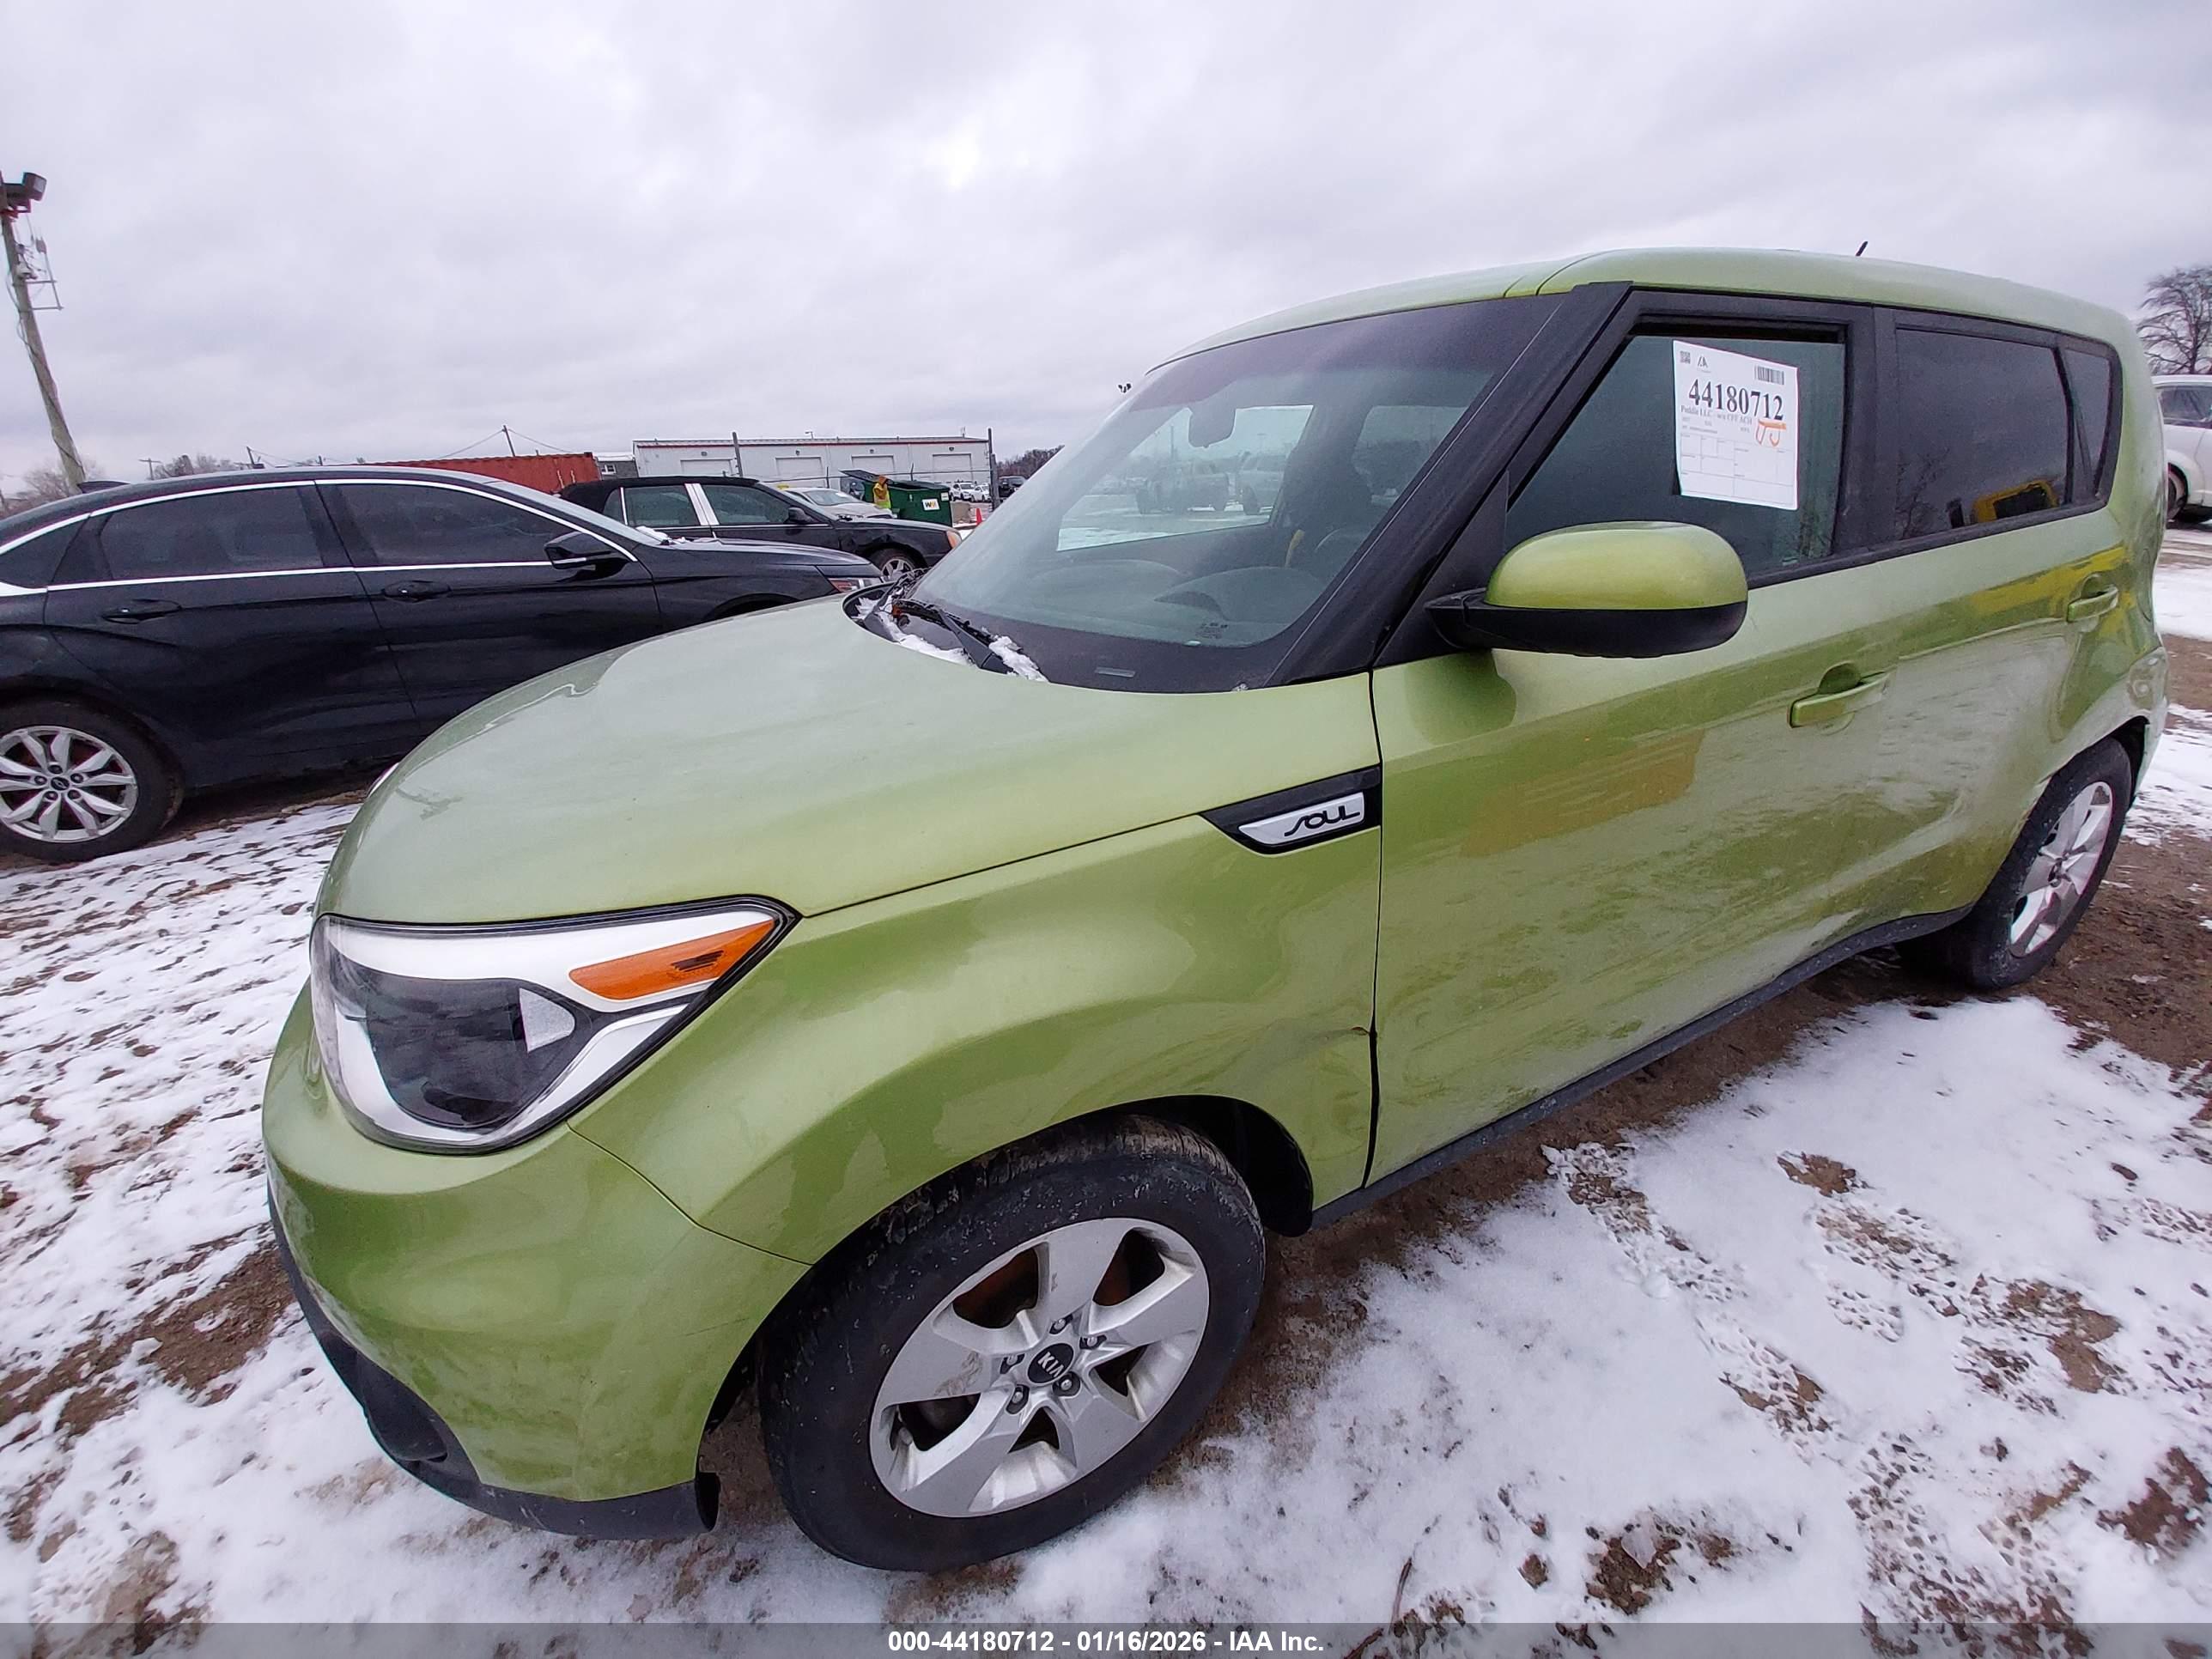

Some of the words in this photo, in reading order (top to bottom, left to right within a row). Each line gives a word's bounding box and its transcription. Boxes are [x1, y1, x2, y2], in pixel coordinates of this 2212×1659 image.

[1689, 379, 1784, 421] 44180712
[1284, 805, 1360, 836] SOUL
[1037, 1352, 1064, 1377] KIA
